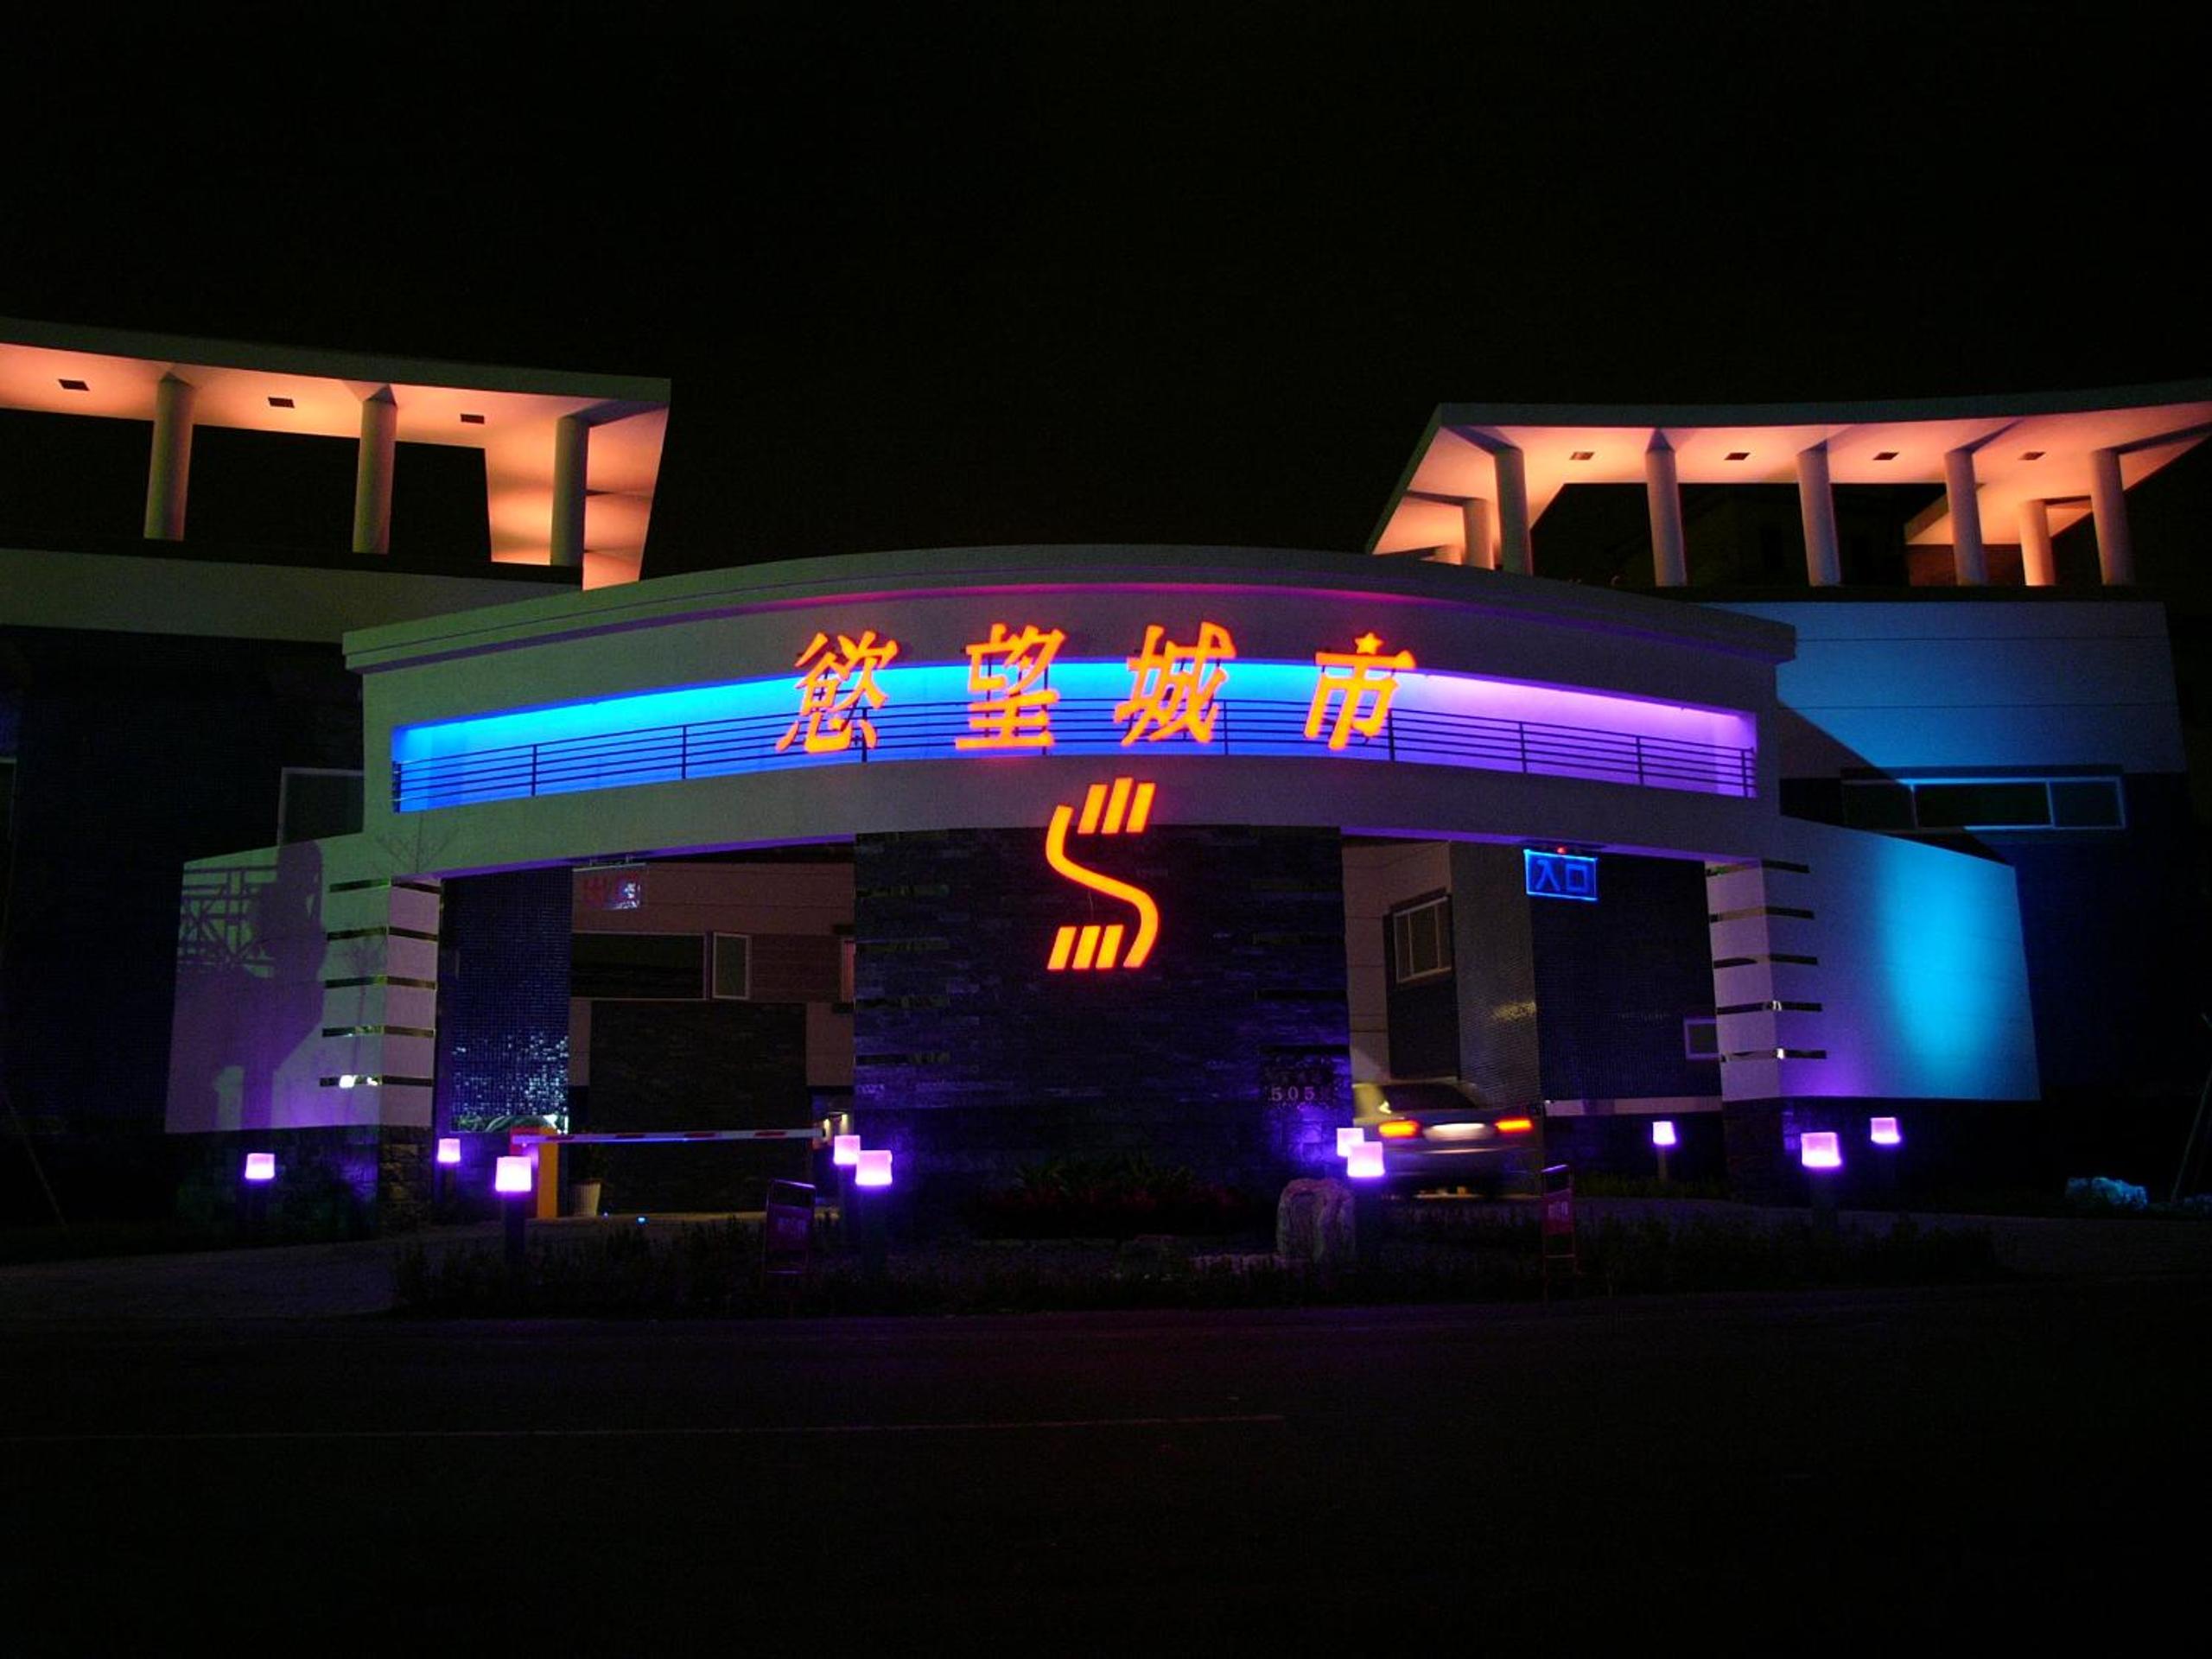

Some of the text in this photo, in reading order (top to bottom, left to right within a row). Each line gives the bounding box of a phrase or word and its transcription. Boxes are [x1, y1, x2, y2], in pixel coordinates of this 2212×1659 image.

[776, 621, 1417, 753] 慾望城市
[1535, 859, 1588, 893] 入口
[1270, 1084, 1315, 1102] 505
